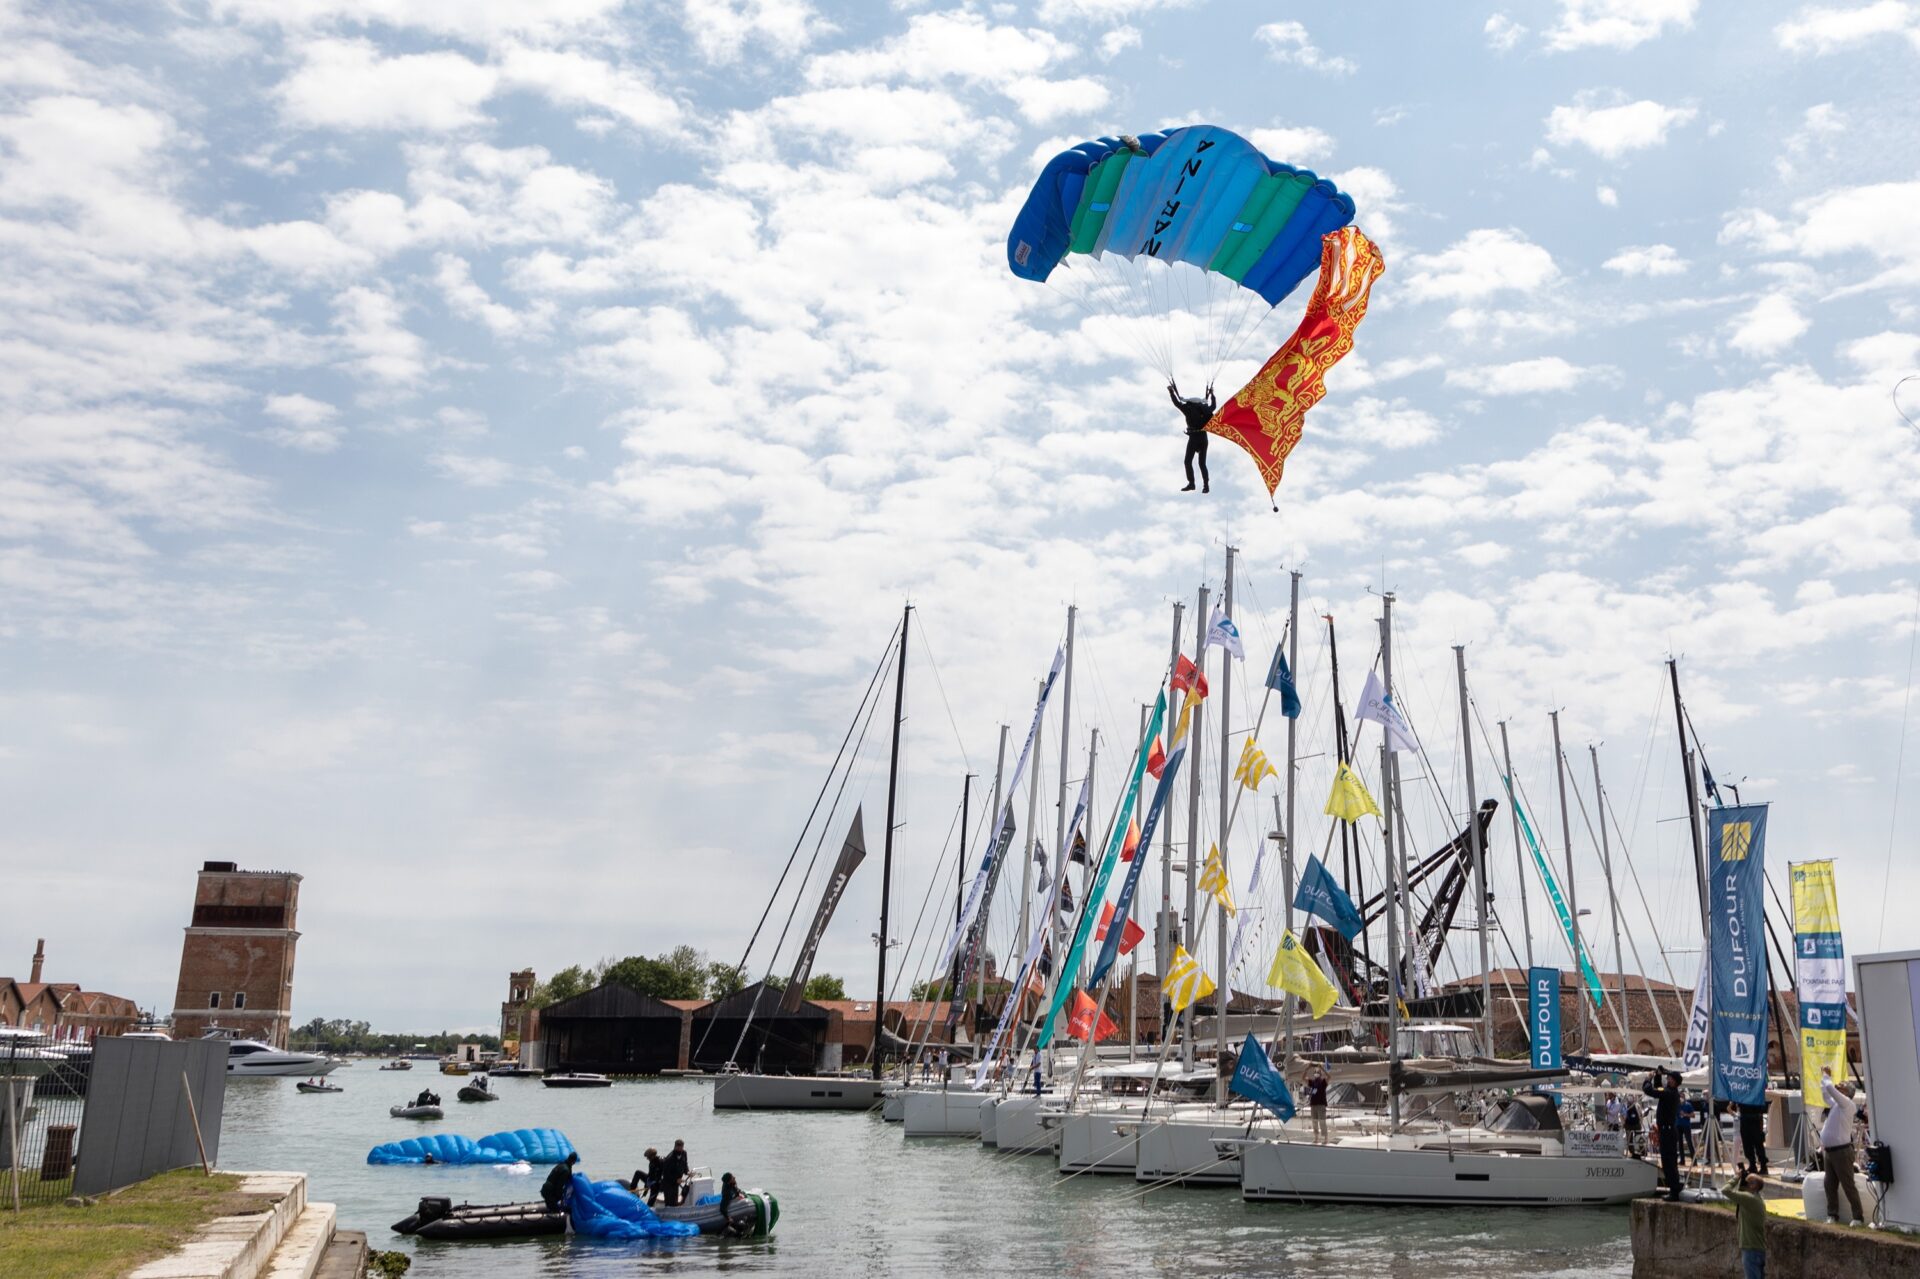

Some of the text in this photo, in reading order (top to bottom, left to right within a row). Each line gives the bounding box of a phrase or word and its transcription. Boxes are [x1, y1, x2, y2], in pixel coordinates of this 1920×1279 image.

[1122, 805, 1160, 899] DUFOUR
[1726, 874, 1748, 997] DUFOUR
[1538, 979, 1552, 1066] DUFOUR
[1571, 1062, 1627, 1074] JEANNEAU
